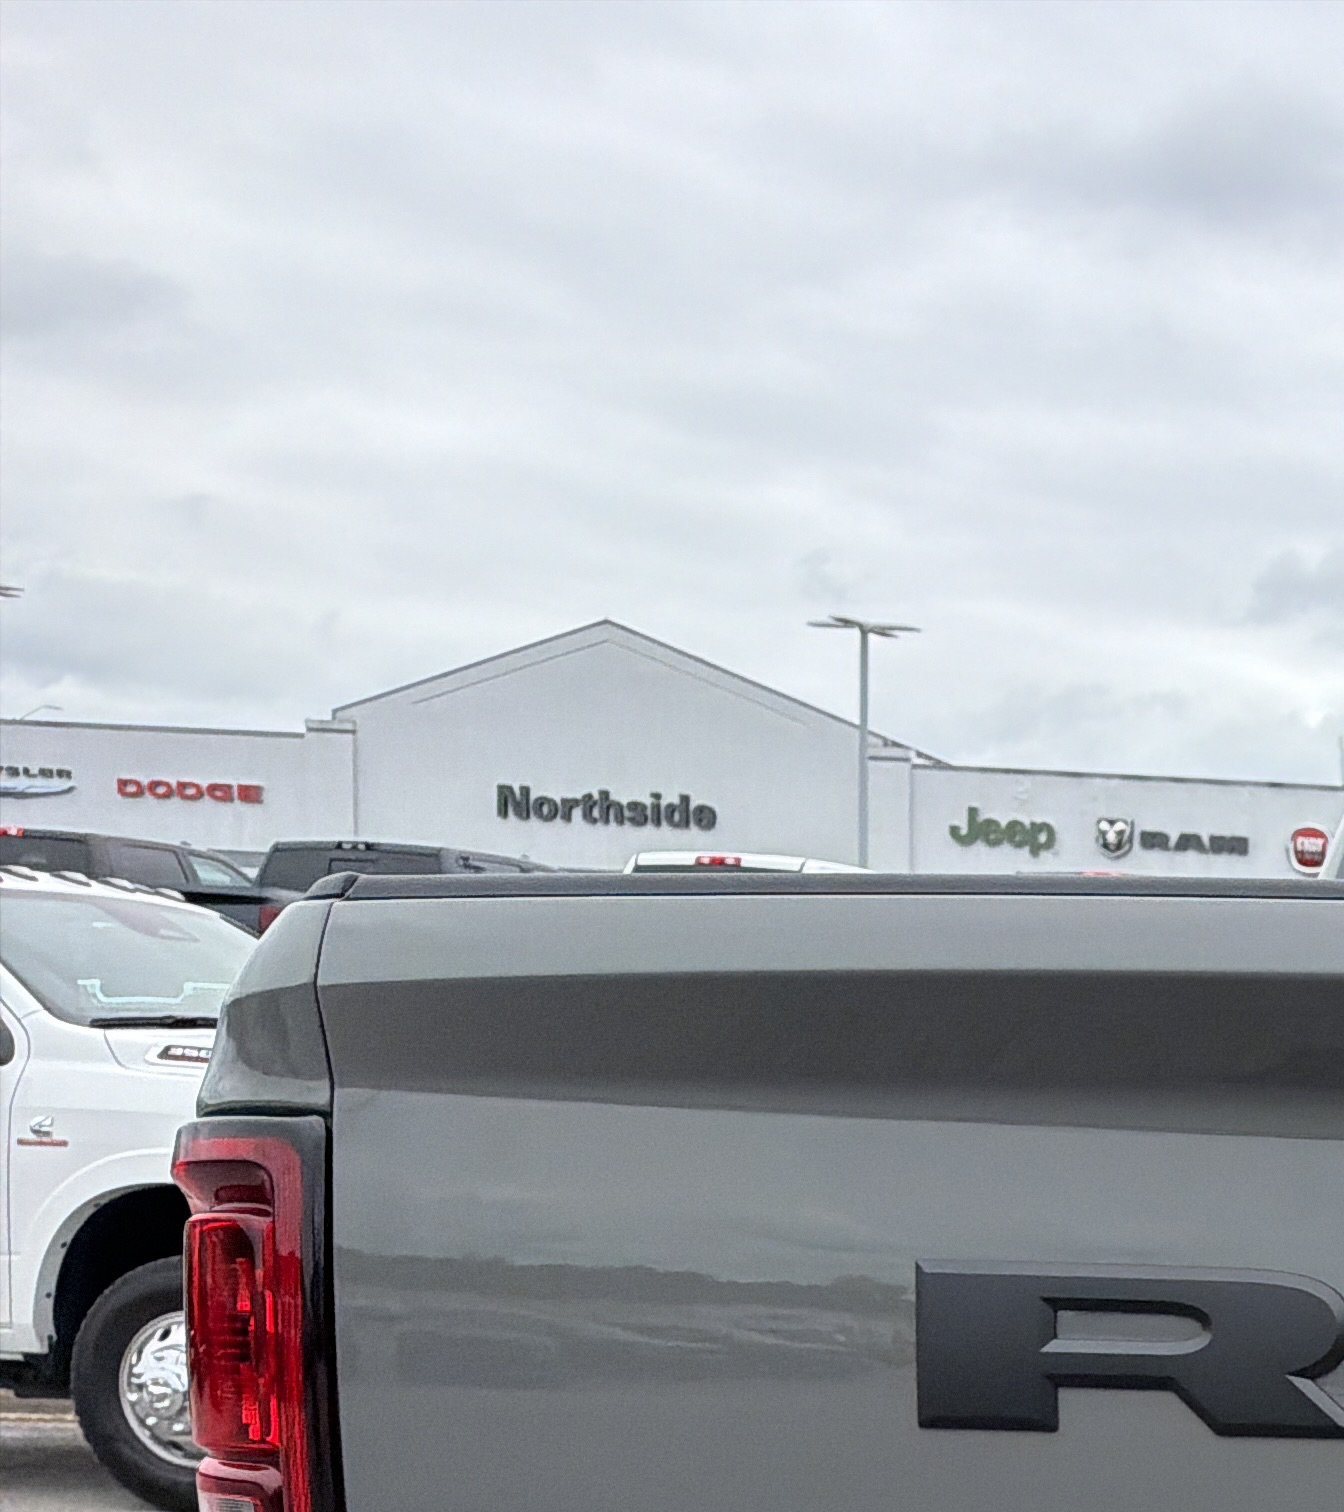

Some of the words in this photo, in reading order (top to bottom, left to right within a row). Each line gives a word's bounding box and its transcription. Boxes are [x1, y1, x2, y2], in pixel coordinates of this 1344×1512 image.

[117, 778, 265, 804] DODGE
[497, 784, 718, 831] Northside
[949, 806, 1057, 858] Jeep
[1139, 830, 1249, 856] RAM
